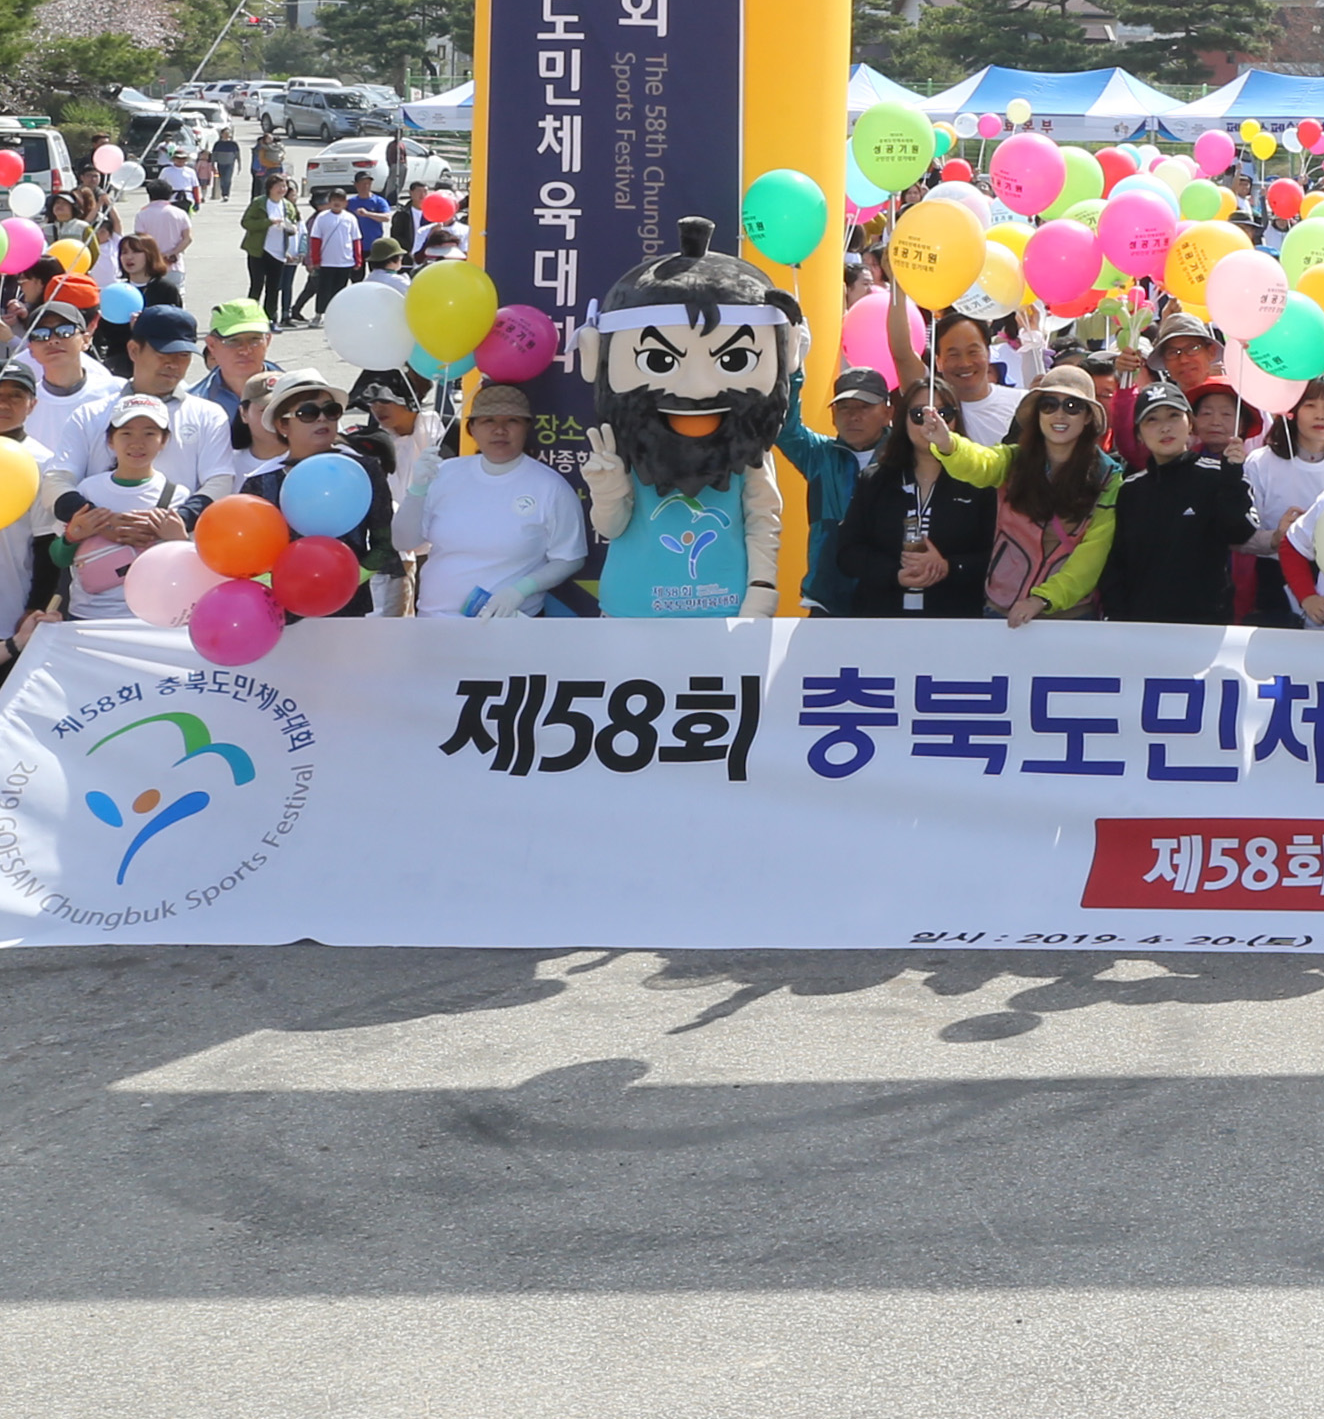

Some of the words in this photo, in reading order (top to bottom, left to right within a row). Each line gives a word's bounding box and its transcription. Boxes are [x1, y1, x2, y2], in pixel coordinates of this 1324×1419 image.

[611, 51, 636, 120] Sports
[643, 53, 668, 96] The
[614, 129, 636, 210] Festival
[644, 104, 668, 157] 58th
[637, 166, 665, 262] Chungb
[534, 414, 586, 445] 장소
[51, 682, 144, 740] 제58회
[155, 669, 316, 753] 충북도민체육대회
[438, 671, 761, 782] 제58회
[39, 892, 177, 931] Chungbuk
[184, 851, 268, 910] Sports
[261, 763, 315, 849] Festival
